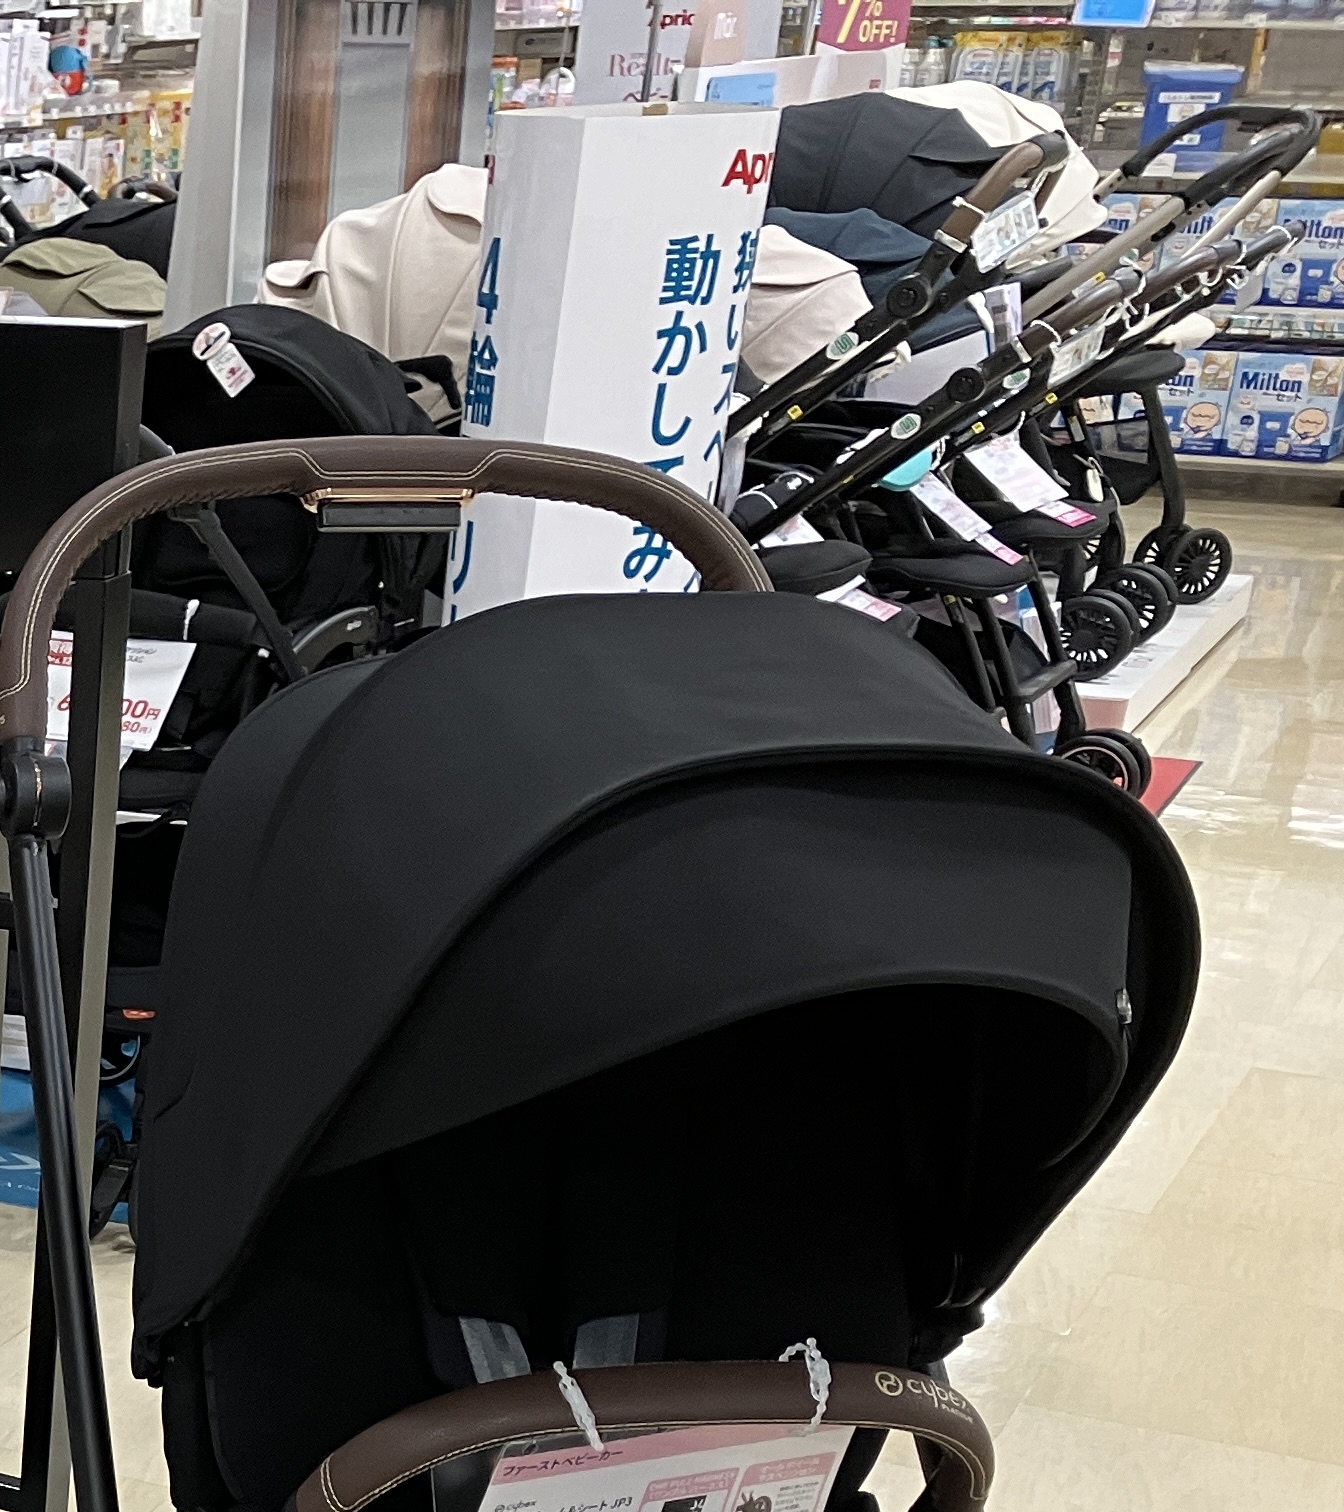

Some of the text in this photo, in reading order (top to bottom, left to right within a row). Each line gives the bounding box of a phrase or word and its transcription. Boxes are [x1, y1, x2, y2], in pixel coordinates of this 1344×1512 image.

[1239, 370, 1303, 393] Milton
[502, 1450, 624, 1477] ファーストベビーカー
[609, 1496, 633, 1510] JP3
